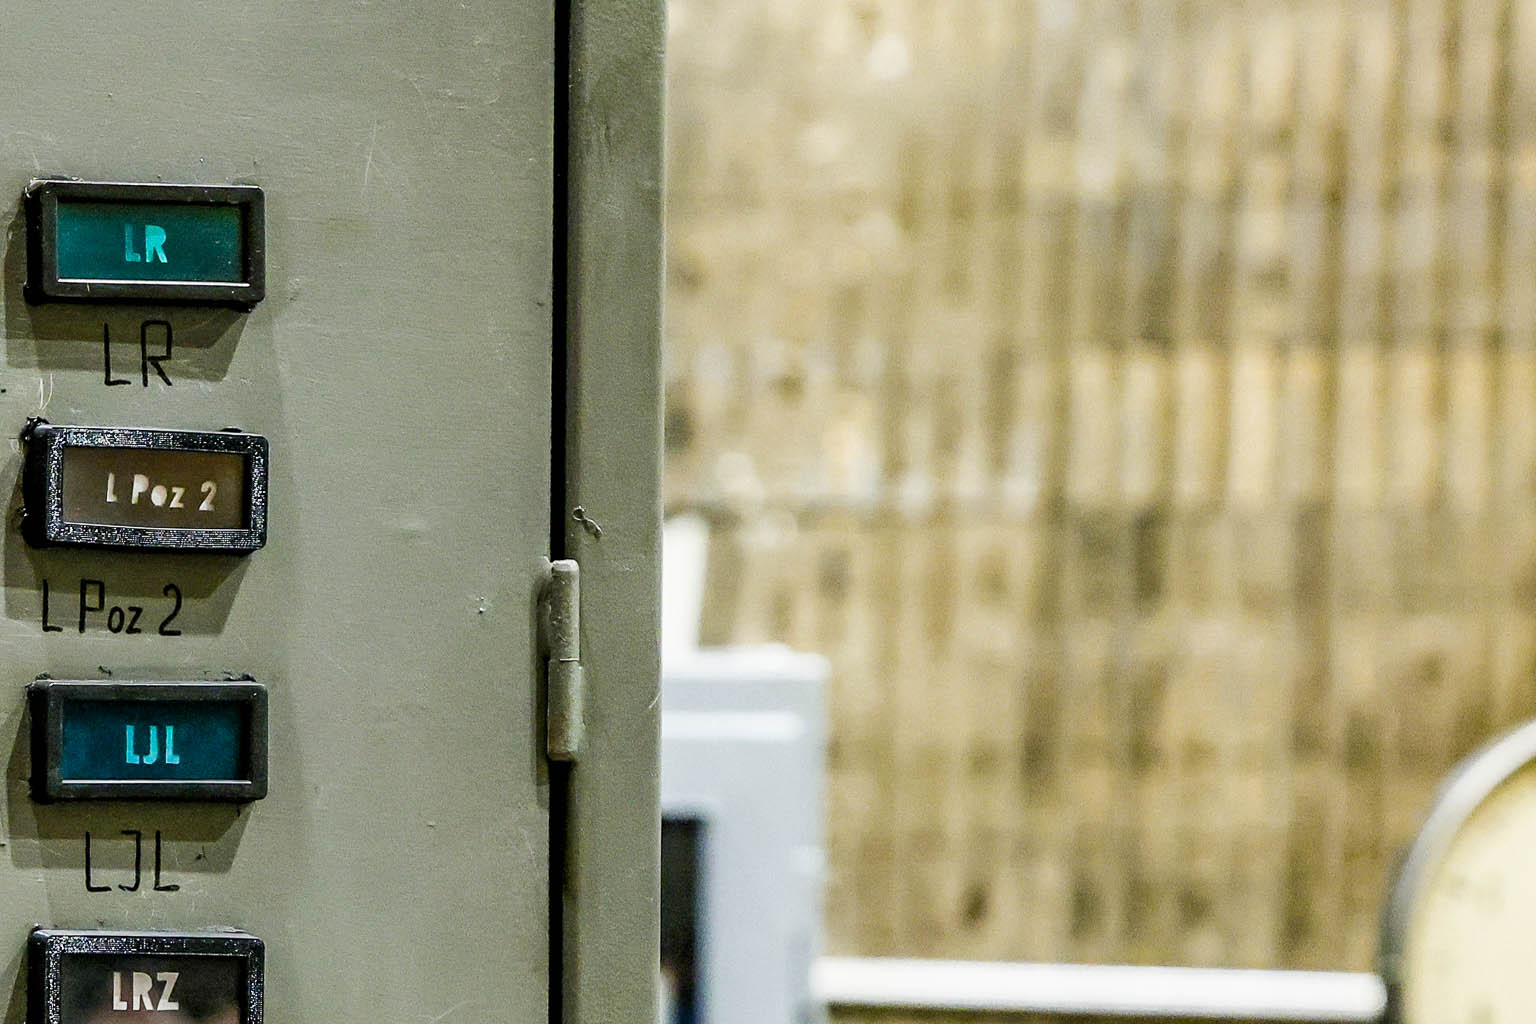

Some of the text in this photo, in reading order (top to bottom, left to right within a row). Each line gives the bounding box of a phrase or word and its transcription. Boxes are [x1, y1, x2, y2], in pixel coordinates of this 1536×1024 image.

[124, 224, 167, 264] LR
[103, 320, 172, 386] LR
[106, 472, 217, 511] L Poz 2
[157, 583, 182, 636] 2
[125, 725, 180, 765] LJL
[85, 830, 180, 891] LJL
[112, 972, 180, 1011] LRZ
